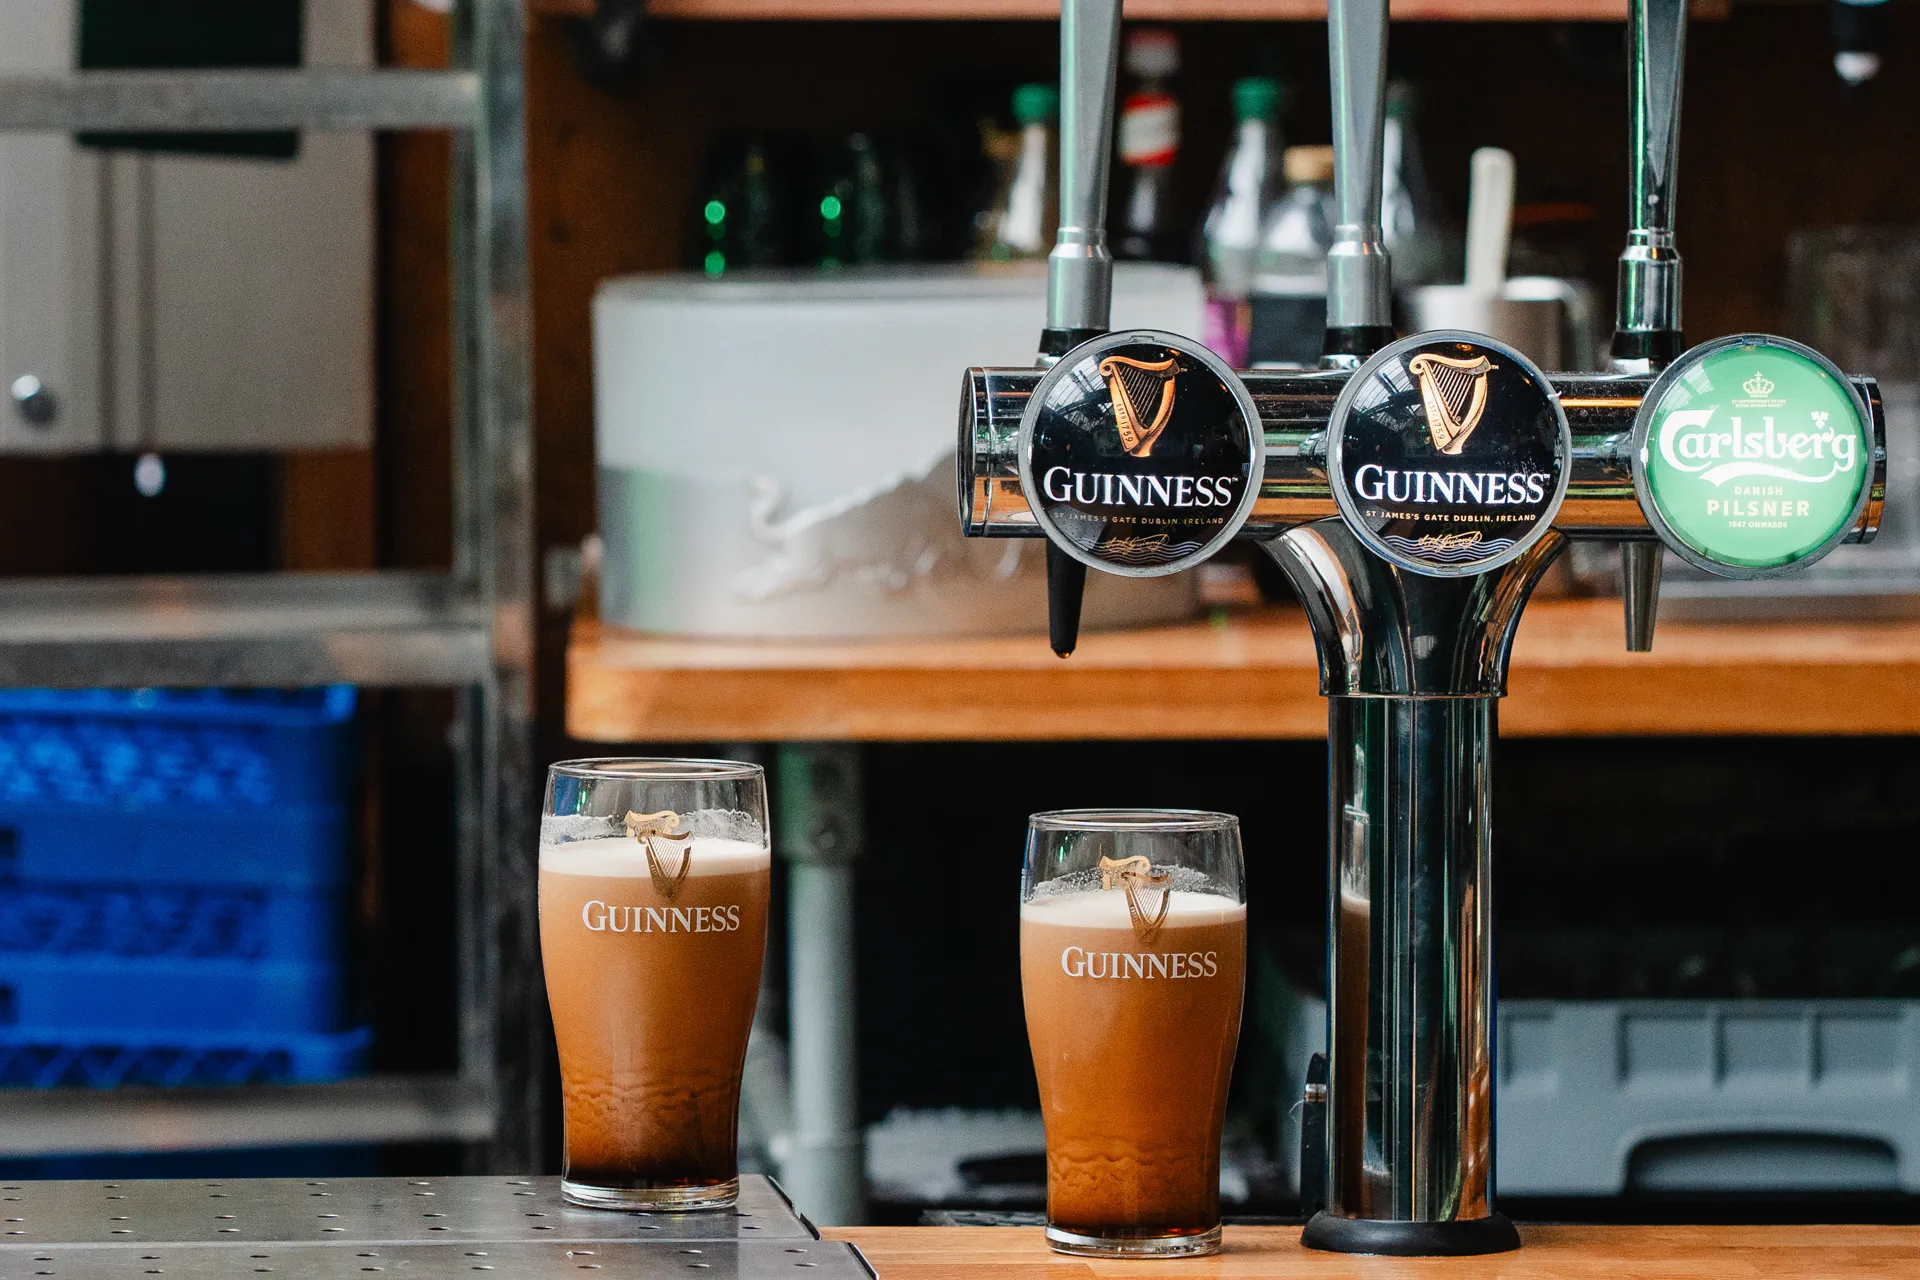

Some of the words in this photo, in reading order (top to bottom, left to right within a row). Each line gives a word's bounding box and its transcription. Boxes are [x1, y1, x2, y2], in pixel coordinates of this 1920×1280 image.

[1121, 421, 1134, 442] 1759
[1432, 418, 1446, 440] 1759
[1659, 407, 1857, 474] Carlsberg
[1734, 486, 1783, 496] DANISH
[1380, 511, 1420, 521] JAMES'S
[1424, 514, 1450, 522] GATE
[1496, 514, 1536, 522] IRELAND
[1706, 500, 1810, 517] PILSNER
[1068, 514, 1108, 522] JAMES'S
[1111, 516, 1138, 524] GATE
[1183, 517, 1224, 525] IRELAND
[581, 900, 741, 933] GUINNESS
[1061, 946, 1218, 979] GUINNESS
